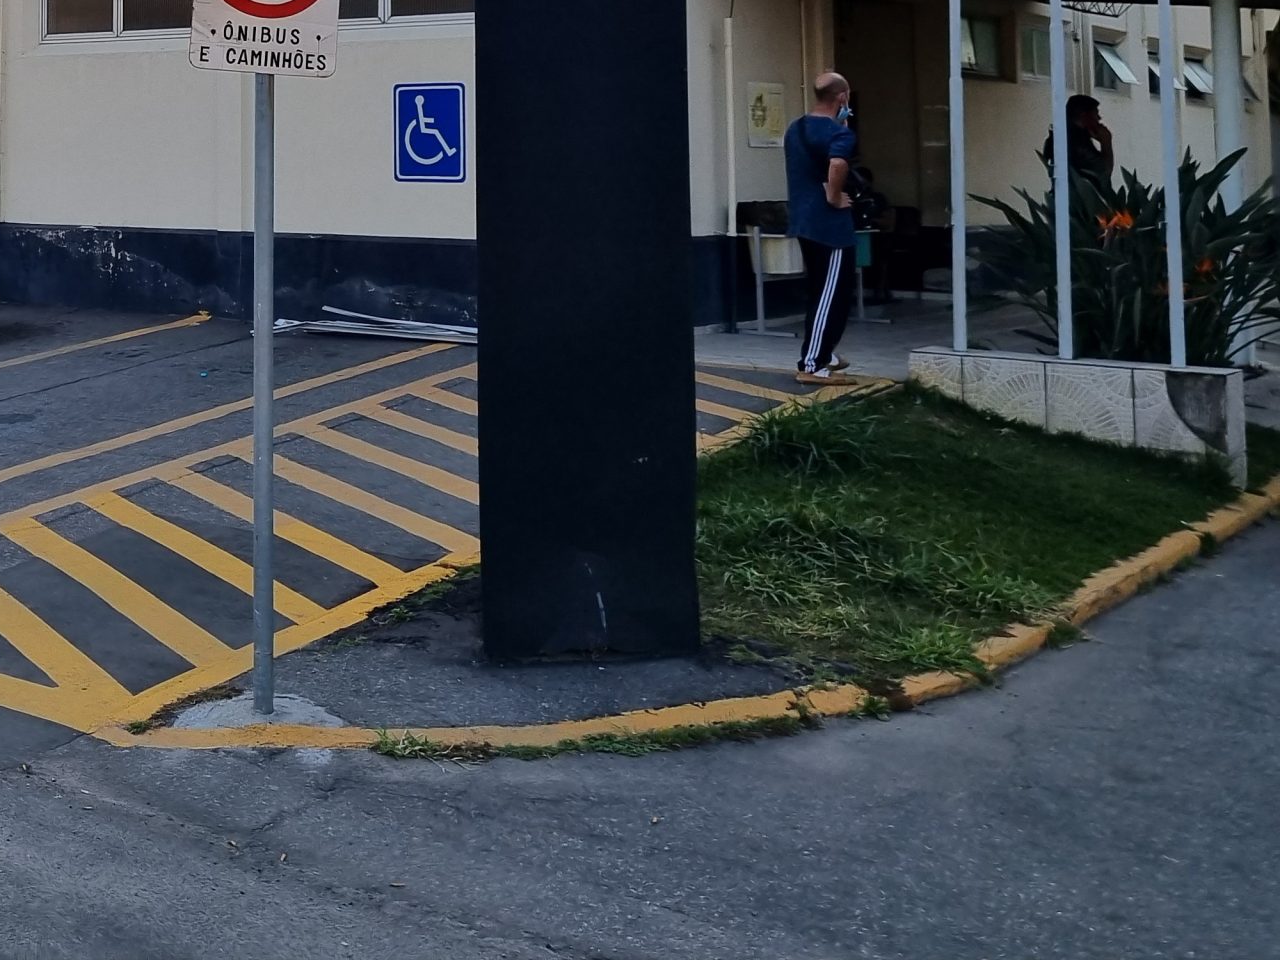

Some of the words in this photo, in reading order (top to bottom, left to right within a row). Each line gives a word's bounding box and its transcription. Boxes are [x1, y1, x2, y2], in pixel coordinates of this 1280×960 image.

[222, 20, 301, 45] ÔNIBUS
[199, 46, 211, 63] E
[225, 48, 327, 71] CAMINHÕES
